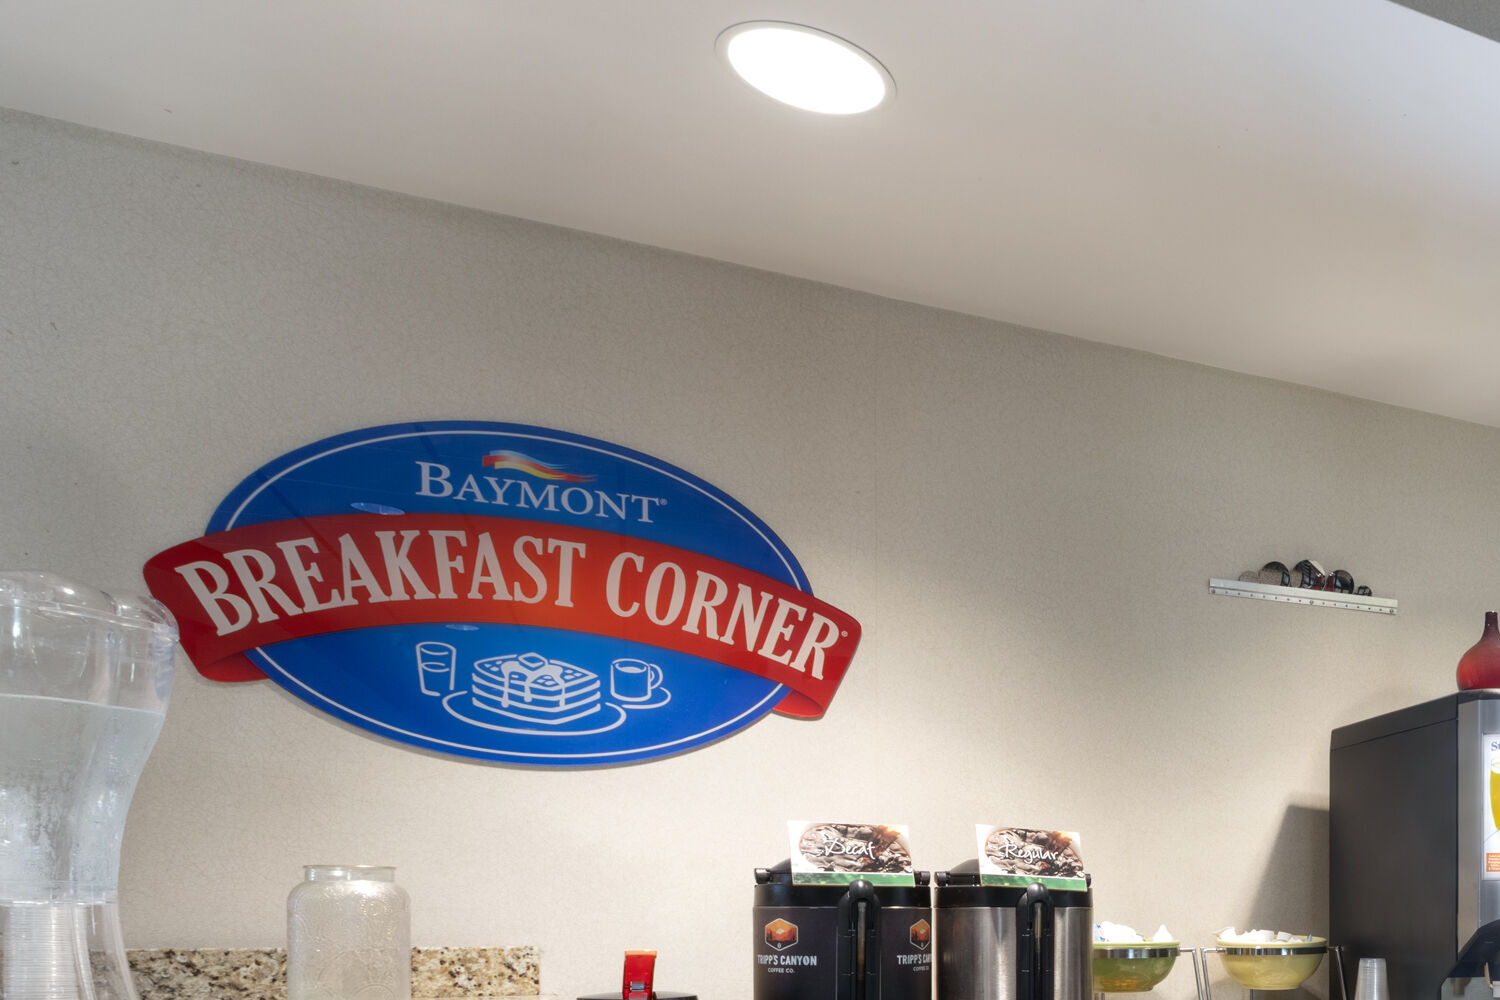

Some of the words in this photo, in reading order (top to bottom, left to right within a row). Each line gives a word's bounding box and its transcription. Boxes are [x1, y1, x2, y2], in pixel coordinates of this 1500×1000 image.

[415, 460, 661, 523] BAYMONT
[174, 529, 587, 638] BREAKFAST
[605, 551, 841, 680] CORNER
[823, 837, 876, 860] Decaf
[999, 843, 1059, 864] Regular
[780, 955, 818, 967] CANYON
